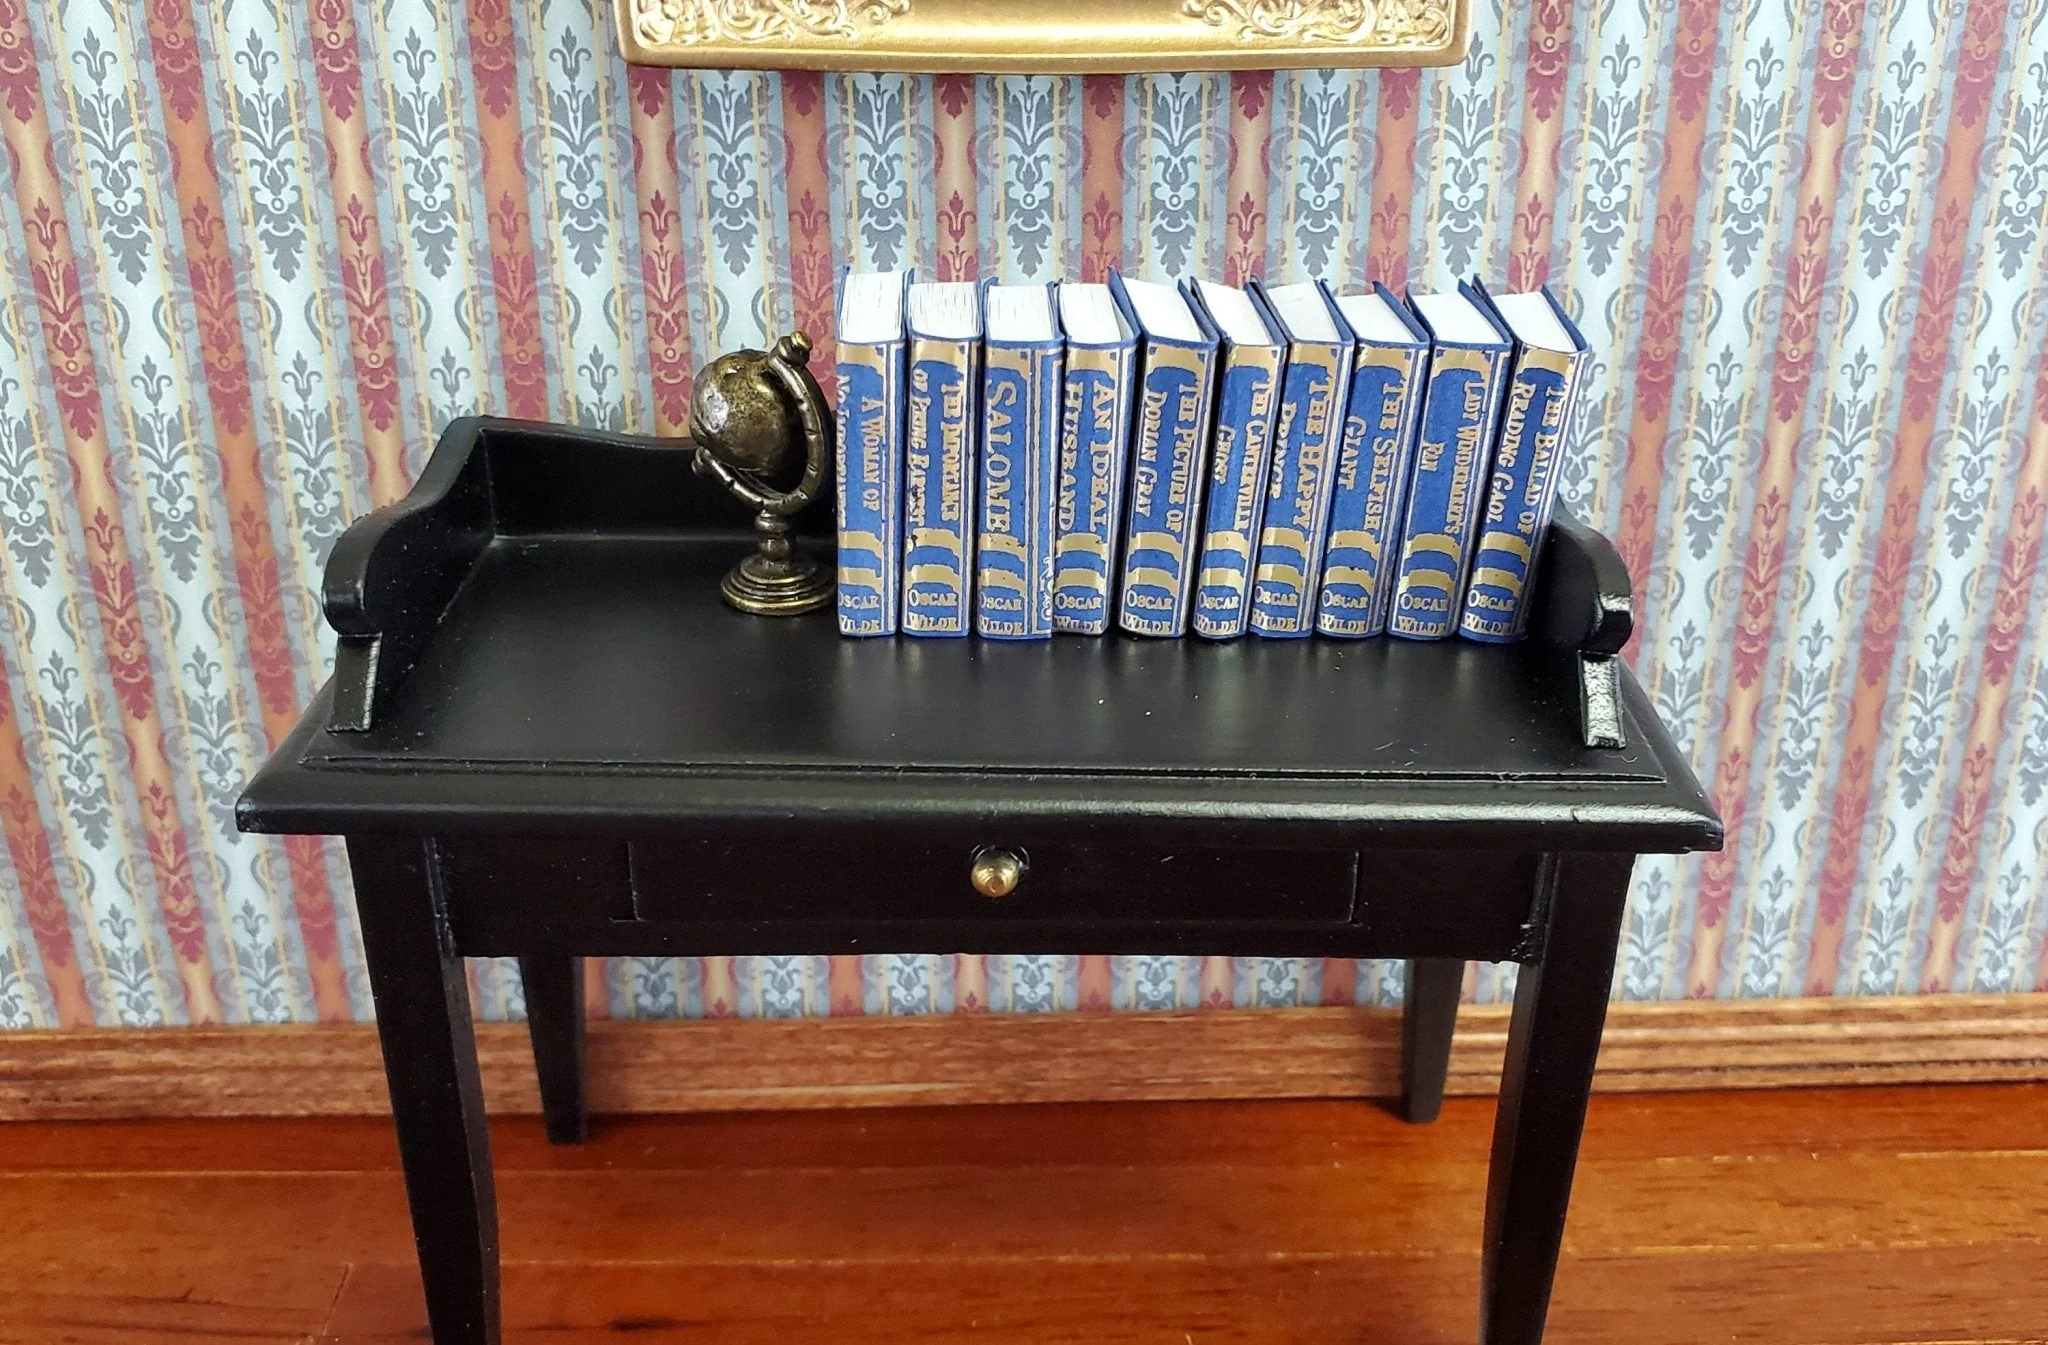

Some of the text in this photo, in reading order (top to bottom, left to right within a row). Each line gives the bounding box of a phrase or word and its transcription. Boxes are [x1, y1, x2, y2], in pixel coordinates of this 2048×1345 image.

[1178, 382, 1200, 422] THE
[985, 380, 1018, 534] SALOME
[1059, 380, 1084, 532] HUSBAND
[1090, 380, 1115, 531] AN IDEAL
[1136, 390, 1167, 517] DORIAN GRAY
[1293, 380, 1331, 530] THE HAPPY
[1338, 416, 1367, 490] GIANT
[1364, 380, 1406, 530] THE SELFISH
[1421, 440, 1444, 472] FAN
[1486, 380, 1536, 524] READING GAOL
[1168, 426, 1198, 505] PICTURE
[1524, 431, 1559, 506] BALLAD
[909, 588, 958, 607] OSCAR
[1055, 592, 1101, 610] OSCAR
[1126, 591, 1172, 610] OSCAR
[1199, 590, 1240, 609] OSCAR
[1254, 585, 1297, 606] OSCAR
[1322, 590, 1368, 608] OSCAR
[1401, 593, 1448, 611] OSCAR
[1468, 590, 1514, 611] OSCAR
[907, 612, 958, 631] WILDE
[1054, 615, 1102, 632] WILDE
[1124, 612, 1171, 633] WILDE
[1252, 608, 1297, 631] WILDE
[1320, 613, 1367, 634] WILDE
[1398, 616, 1446, 635] WILDE
